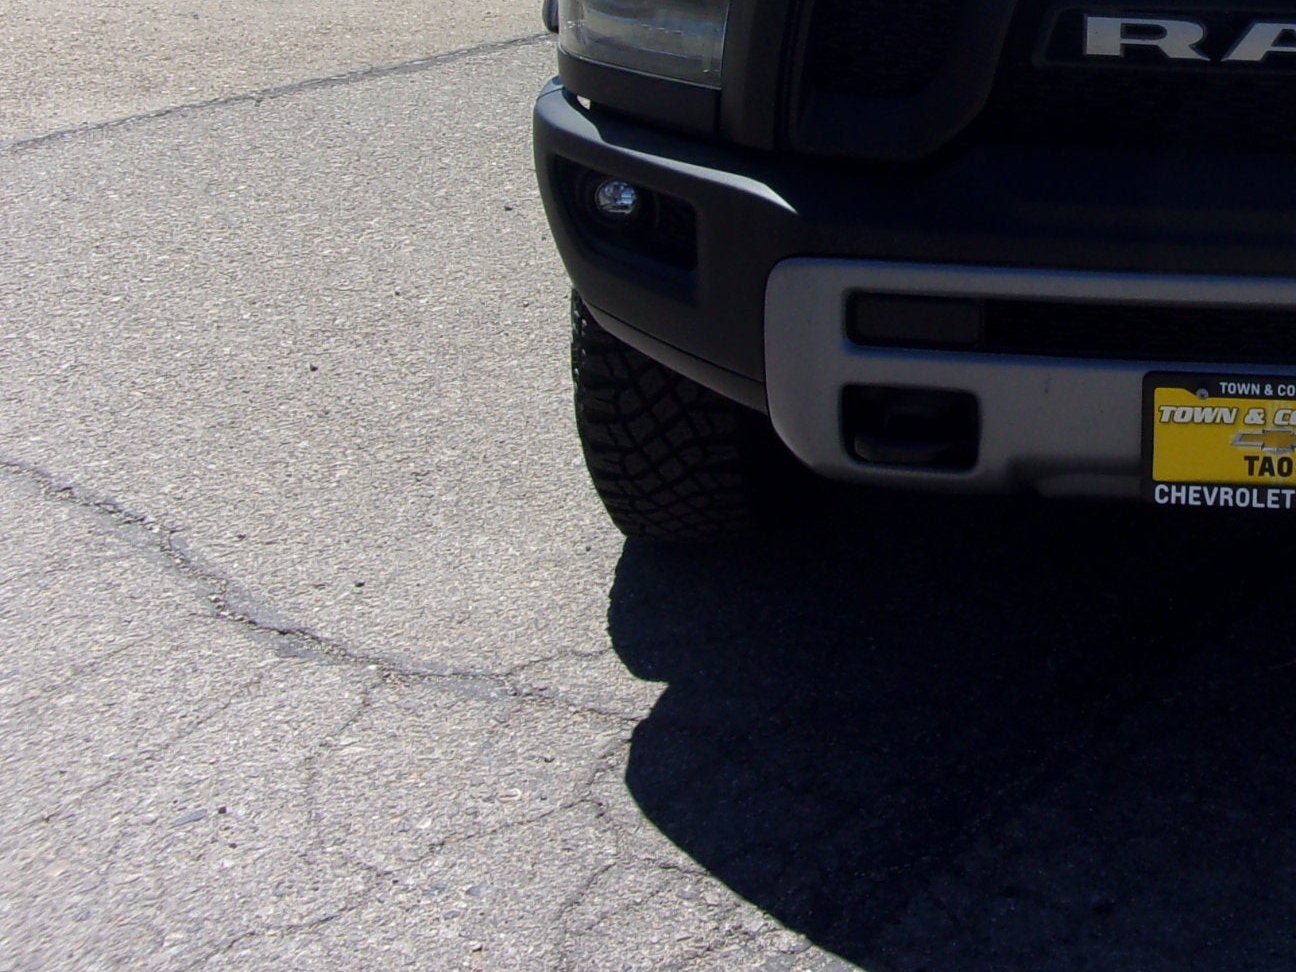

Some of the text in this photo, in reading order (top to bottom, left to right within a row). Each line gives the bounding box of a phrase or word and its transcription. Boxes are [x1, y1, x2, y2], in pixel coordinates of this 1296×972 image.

[1219, 382, 1260, 396] TOWN
[1264, 384, 1273, 396] &
[1159, 405, 1238, 425] TOWN
[1244, 406, 1266, 426] &
[1154, 484, 1295, 509] CHEVROLET
